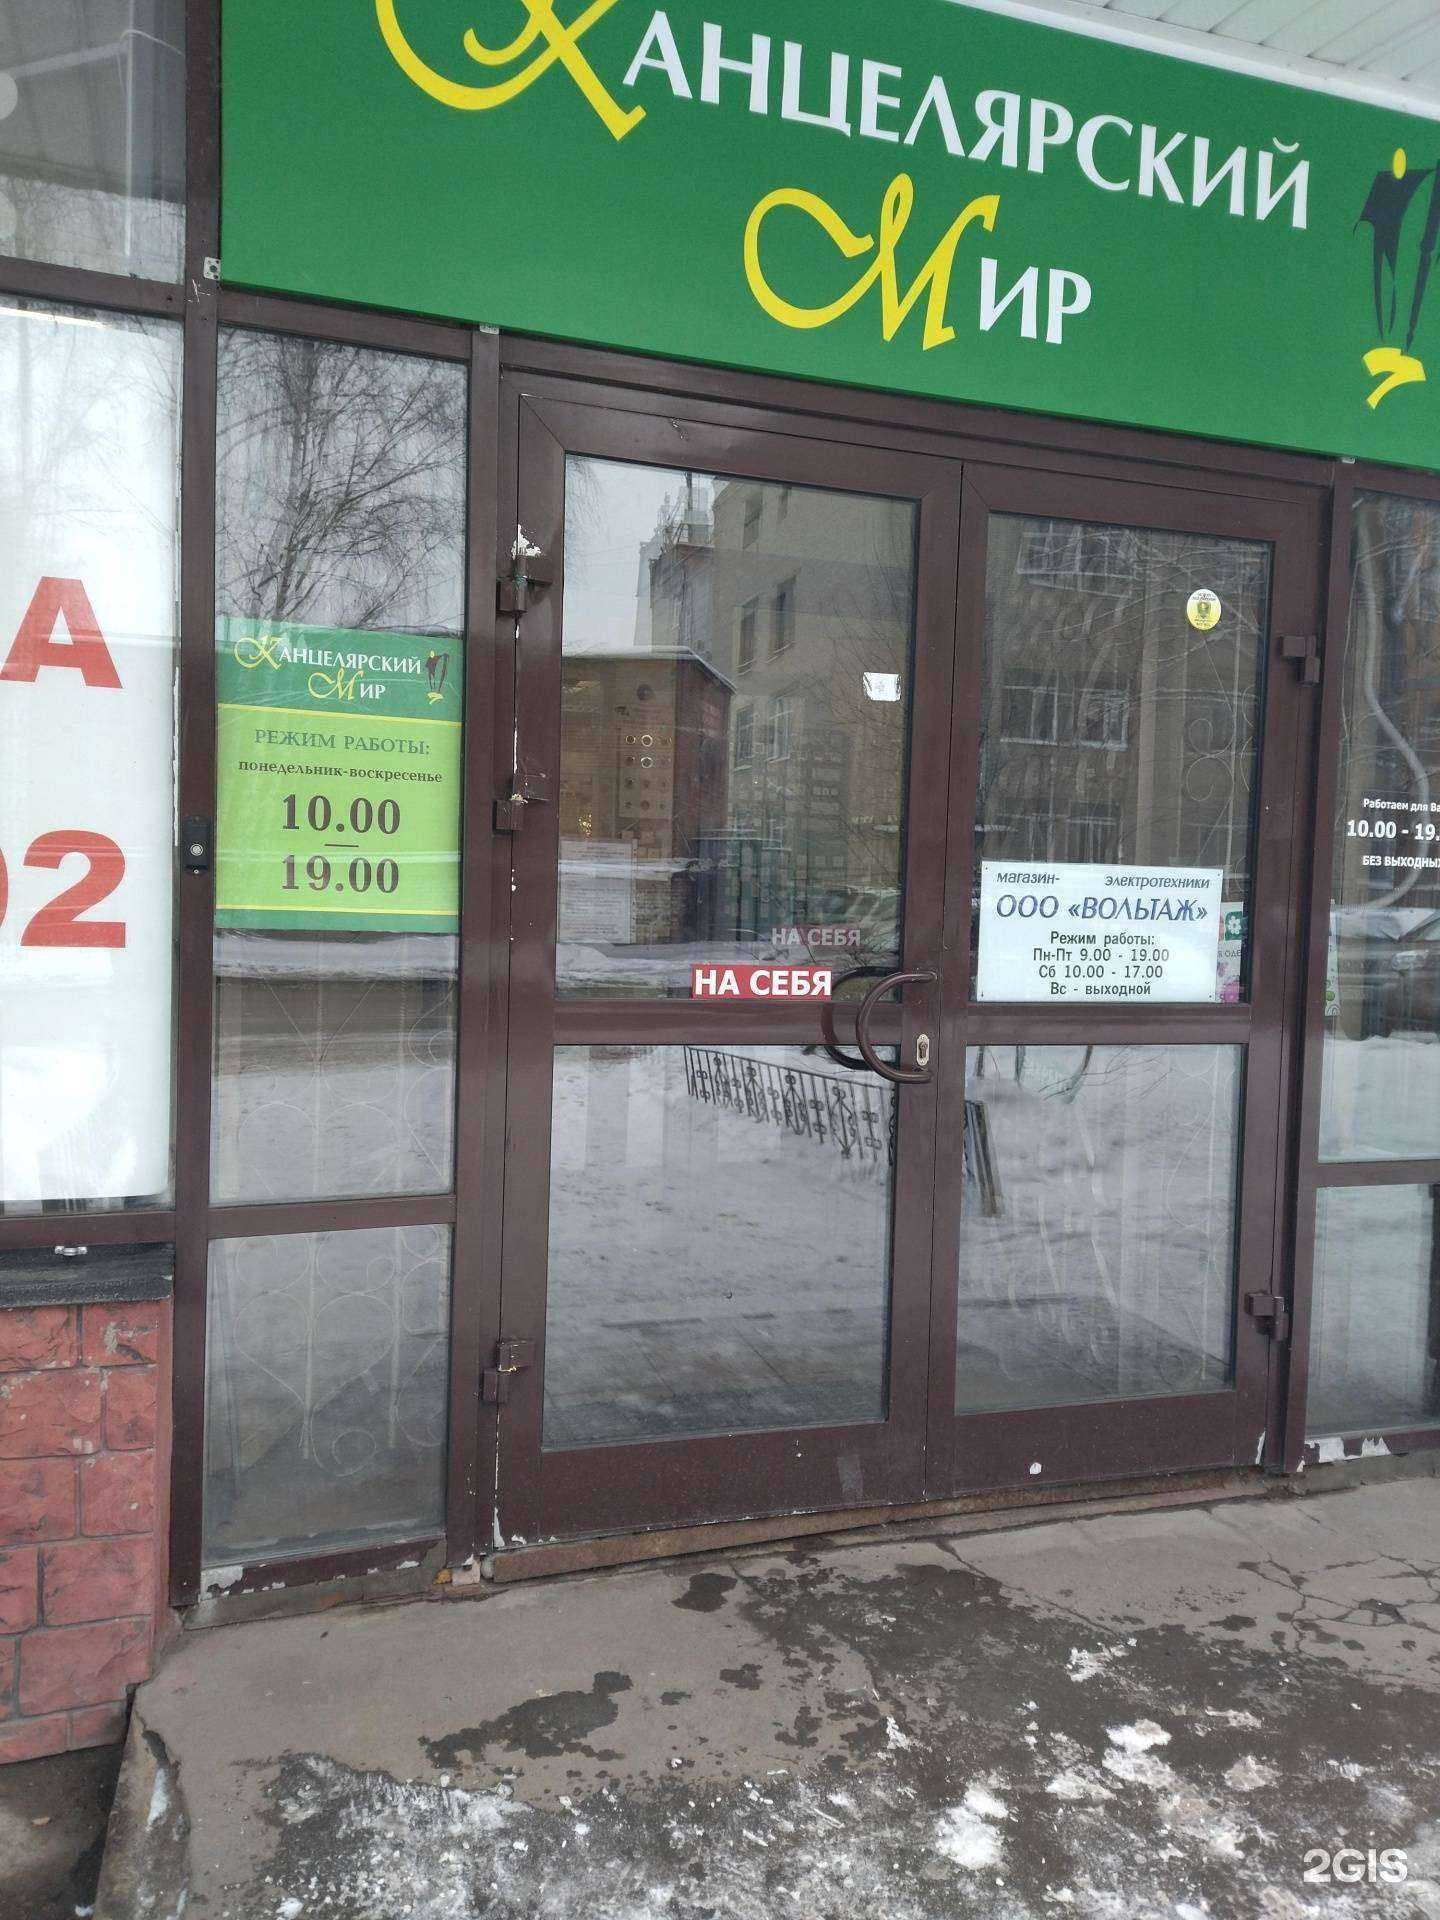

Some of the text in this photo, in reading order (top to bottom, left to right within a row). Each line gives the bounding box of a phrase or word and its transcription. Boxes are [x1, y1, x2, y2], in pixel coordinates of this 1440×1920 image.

[254, 729, 430, 755] РЕЖИМ РАБОТЫ:
[238, 760, 443, 783] понедельник-воскресенье
[282, 794, 401, 835] 10.00
[1363, 798, 1409, 811] Работаем
[1410, 803, 1428, 812] для
[1347, 819, 1397, 839] 10.00
[1362, 855, 1382, 866] БЕЗ
[281, 855, 400, 894] 19.00
[1105, 874, 1210, 890] электротехники
[996, 894, 1060, 918] ООО
[771, 927, 861, 946] НА СЕБЯ
[1050, 931, 1155, 947] Режим работы:
[1033, 948, 1073, 962] Пн-Пт
[1080, 949, 1111, 962] 9.00
[1130, 949, 1169, 962] 19.00
[1038, 965, 1056, 979] Сб
[1064, 966, 1104, 978] 10.00
[1124, 966, 1163, 979] 17.00
[695, 970, 832, 996] НА СЕБЯ
[1051, 983, 1066, 995] Вс
[1085, 983, 1150, 996] выходной
